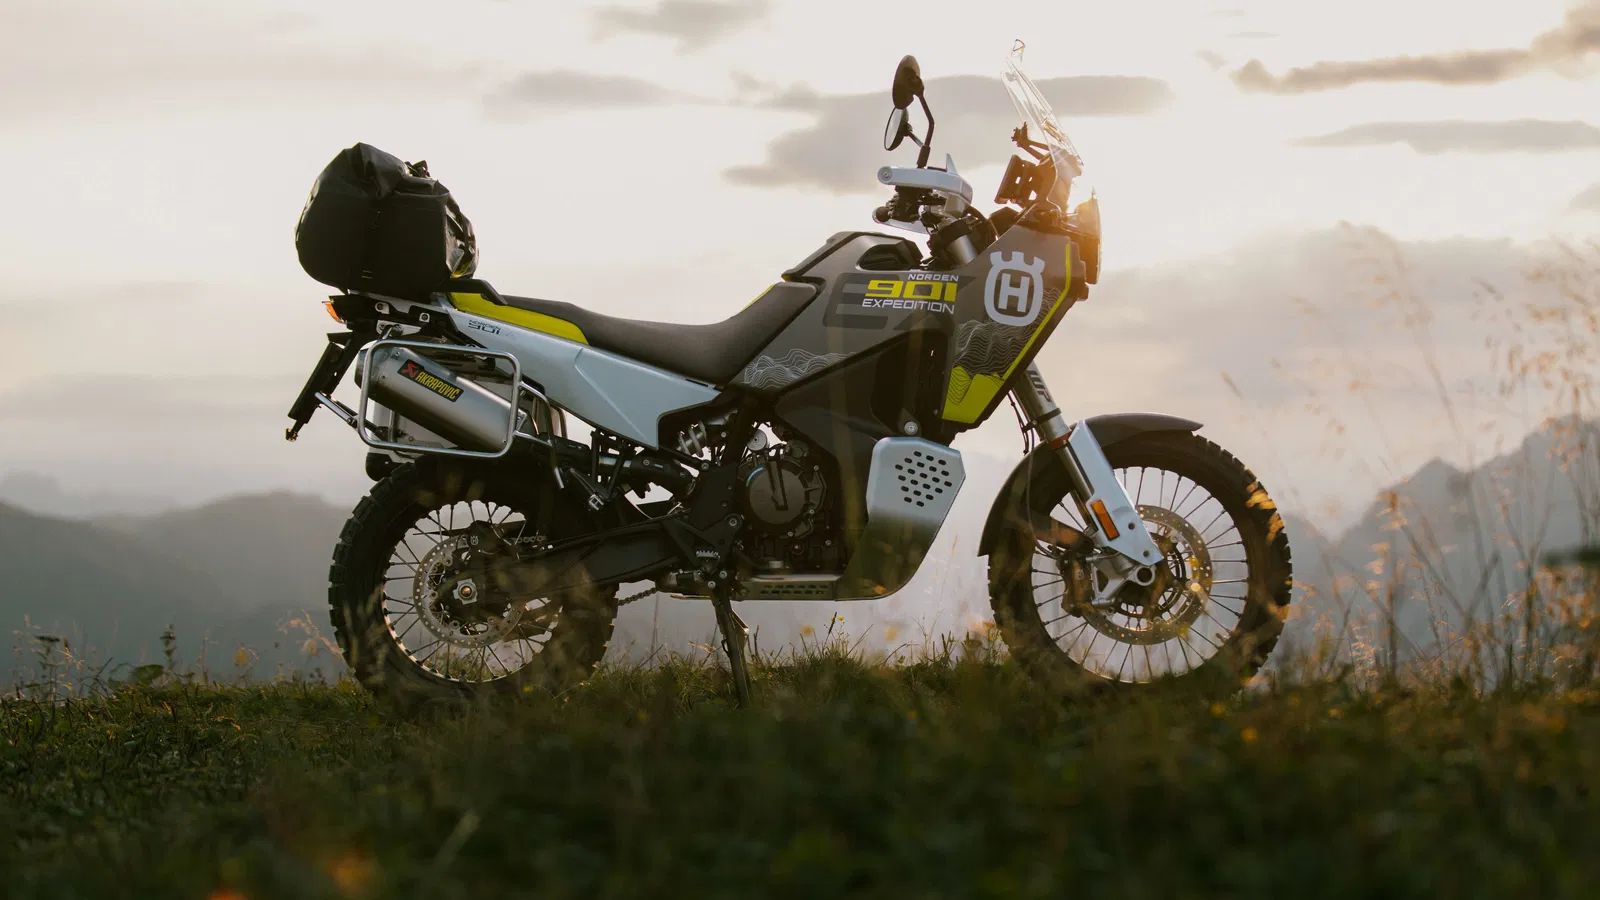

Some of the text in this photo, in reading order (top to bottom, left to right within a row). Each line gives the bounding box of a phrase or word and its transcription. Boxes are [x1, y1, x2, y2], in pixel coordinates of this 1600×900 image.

[907, 273, 959, 282] NORDEN
[865, 279, 958, 302] 901
[998, 272, 1030, 313] H
[862, 298, 955, 315] EXPEDITION
